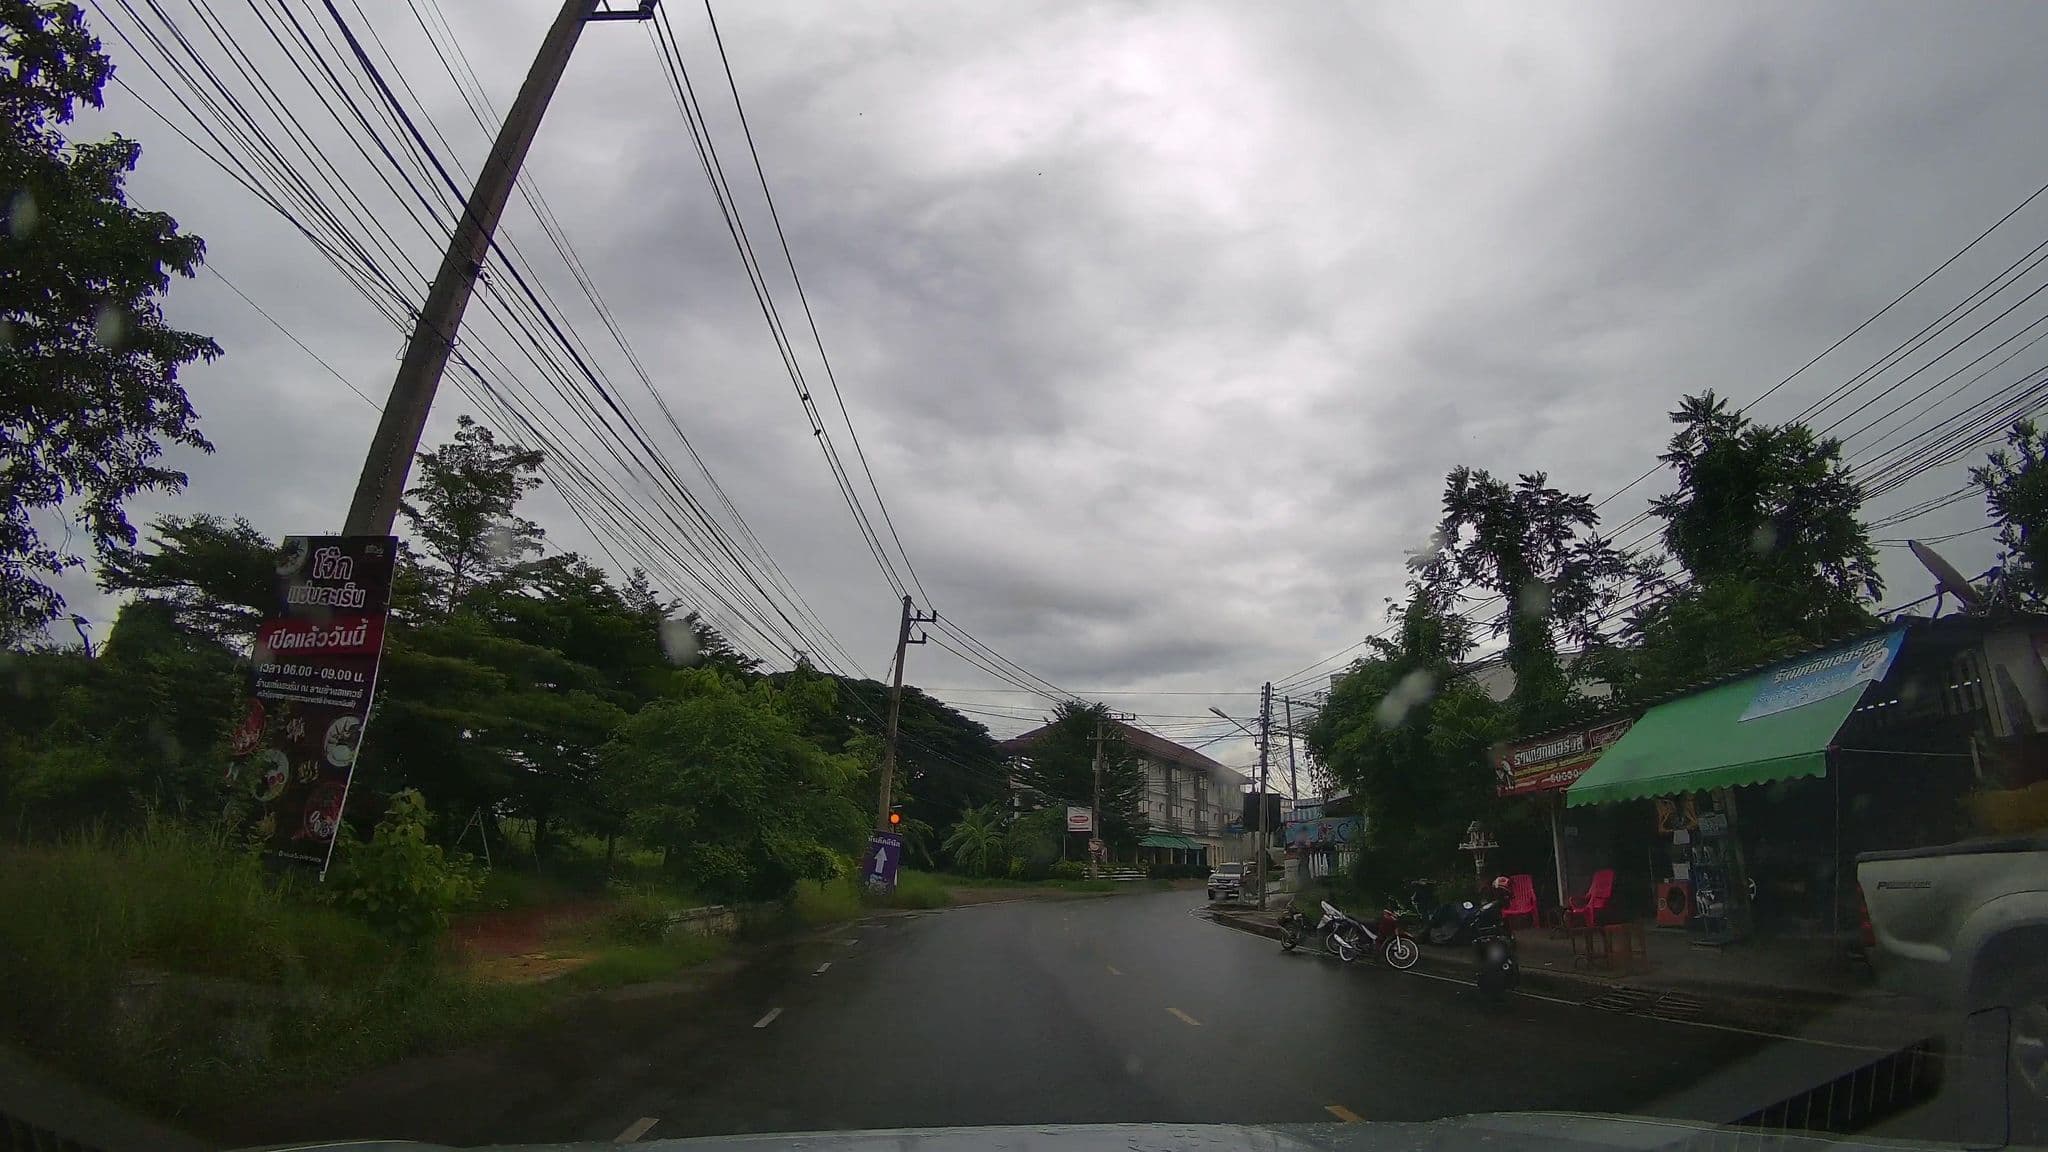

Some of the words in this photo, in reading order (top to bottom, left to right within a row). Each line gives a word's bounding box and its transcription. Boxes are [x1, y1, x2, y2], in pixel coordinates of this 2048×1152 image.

[313, 546, 353, 580] โจ๊ก
[267, 618, 368, 649] เปิดแล้ววันนี้
[283, 664, 312, 677] 06.00
[321, 668, 352, 681] 09.00
